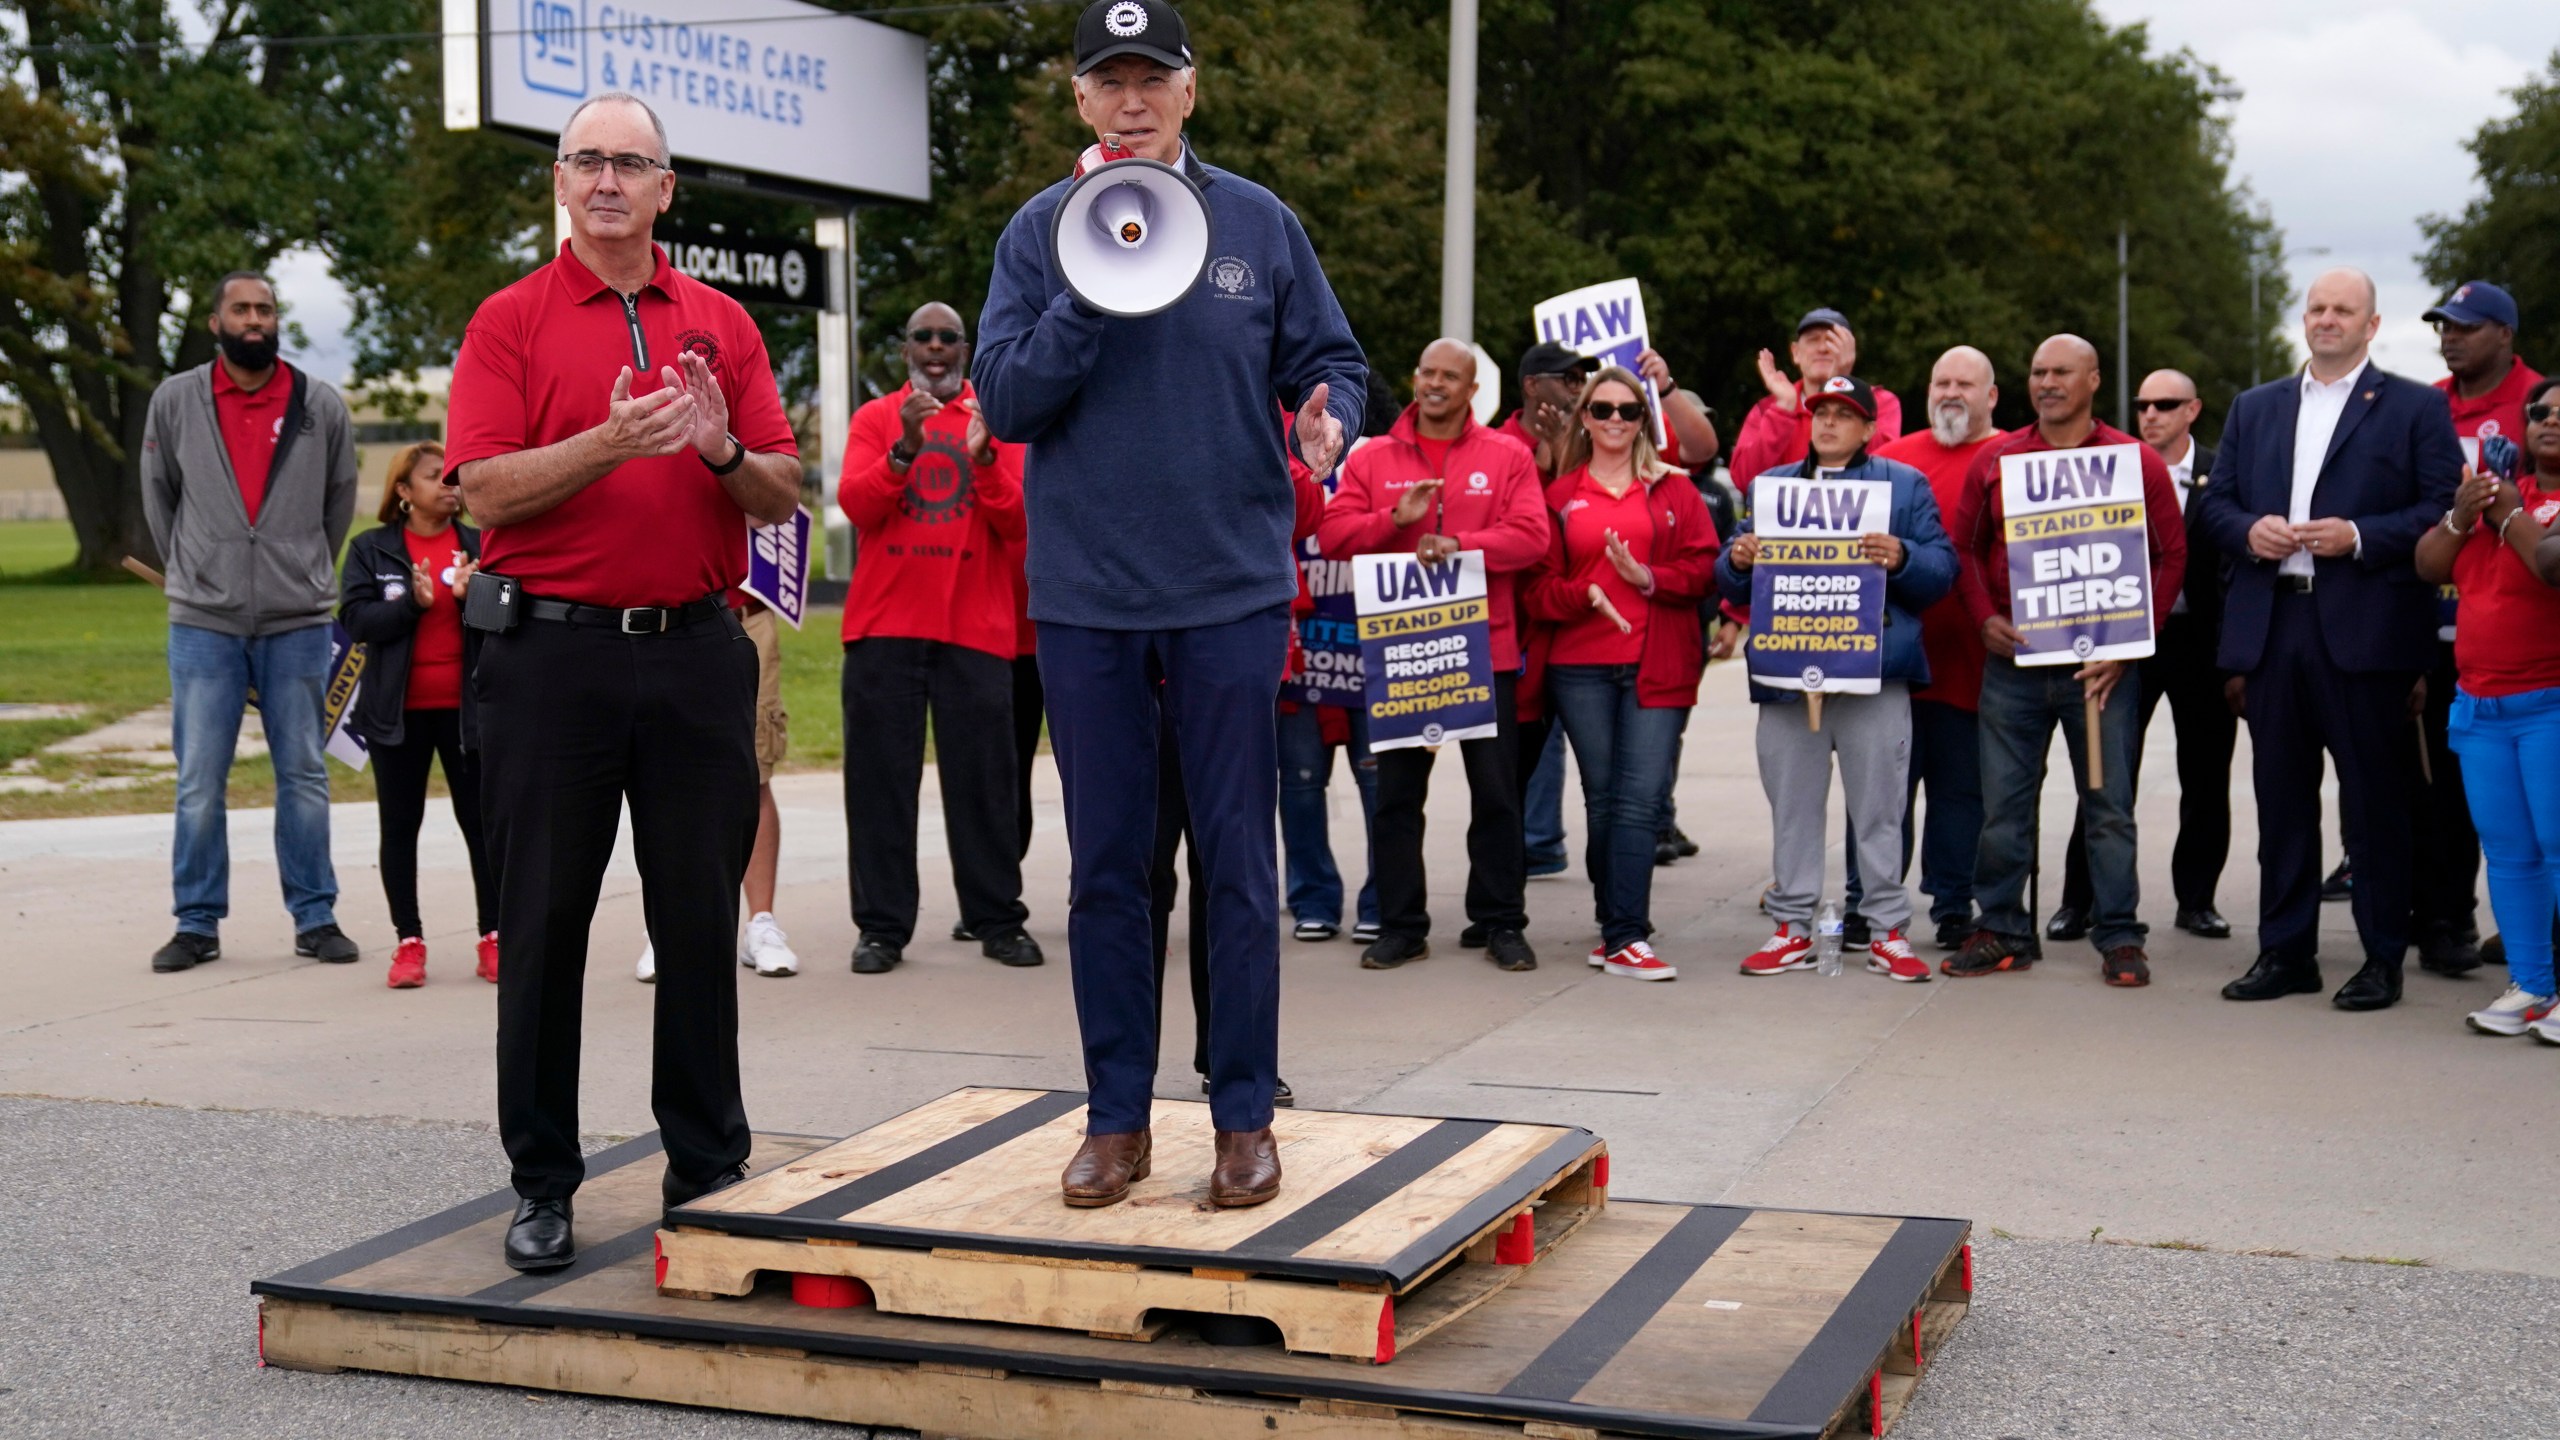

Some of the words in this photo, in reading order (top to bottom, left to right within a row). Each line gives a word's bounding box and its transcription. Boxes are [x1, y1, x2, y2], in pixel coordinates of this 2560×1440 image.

[532, 1, 576, 59] gm
[1116, 13, 1137, 23] UAW
[599, 5, 751, 74] CUSTOMER
[762, 46, 828, 92] CARE
[602, 51, 618, 87] &
[630, 59, 804, 126] AFTERSALES
[674, 242, 744, 285] LOCAL
[744, 252, 778, 289] 174
[1231, 255, 1250, 269] UNITED
[1248, 268, 1256, 287] STATES
[1542, 296, 1632, 347] UAW
[2024, 453, 2118, 503] UAW
[1776, 485, 1870, 531] UAW
[2014, 512, 2095, 538] STAND
[2103, 507, 2136, 526] UP
[1761, 544, 1839, 560] STAND
[1847, 545, 1871, 560] U
[2032, 542, 2123, 583] END
[1376, 558, 1462, 603] UAW
[1773, 575, 1861, 593] RECORD
[1772, 593, 1861, 612] PROFITS
[2016, 574, 2143, 620] TIERS
[1367, 611, 1442, 636] STAND
[1450, 604, 1480, 622] UP
[1772, 615, 1859, 632] RECORD
[2018, 622, 2031, 631] NO
[2032, 619, 2056, 630] MORE
[2075, 614, 2102, 625] CLASS
[2102, 609, 2145, 621] WORKERS
[1384, 634, 1468, 662] RECORD
[1753, 633, 1877, 652] CONTRACTS
[1385, 650, 1470, 679] PROFITS
[1388, 671, 1470, 699] RECORD
[1371, 685, 1491, 719] CONTRACTS
